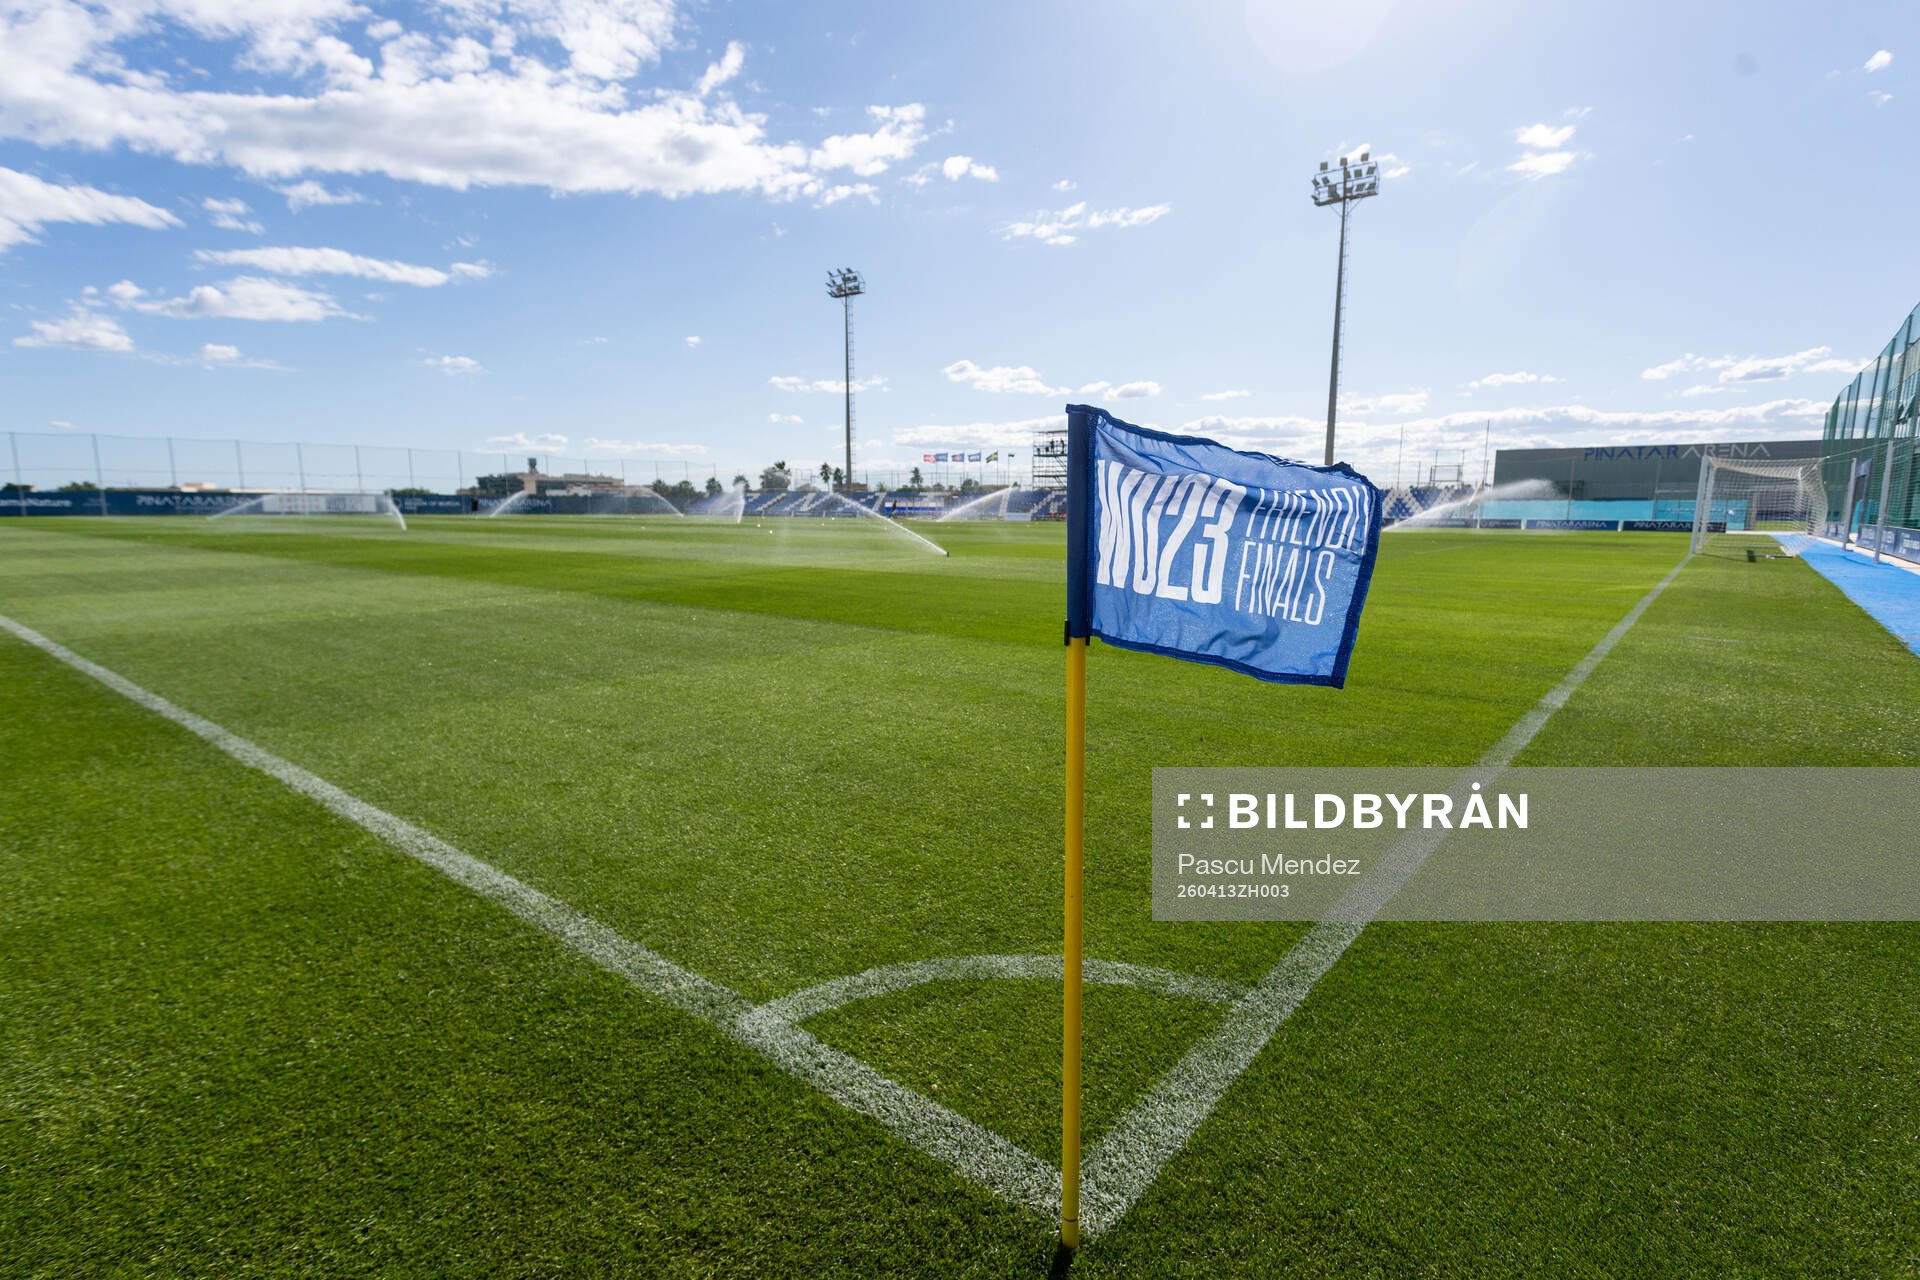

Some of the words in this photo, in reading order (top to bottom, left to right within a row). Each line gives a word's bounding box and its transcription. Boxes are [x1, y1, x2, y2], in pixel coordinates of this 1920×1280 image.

[1584, 445, 1679, 461] PINATAR
[1681, 443, 1771, 459] ARENA
[1096, 459, 1247, 605] WU23
[1235, 540, 1335, 625] FINALS
